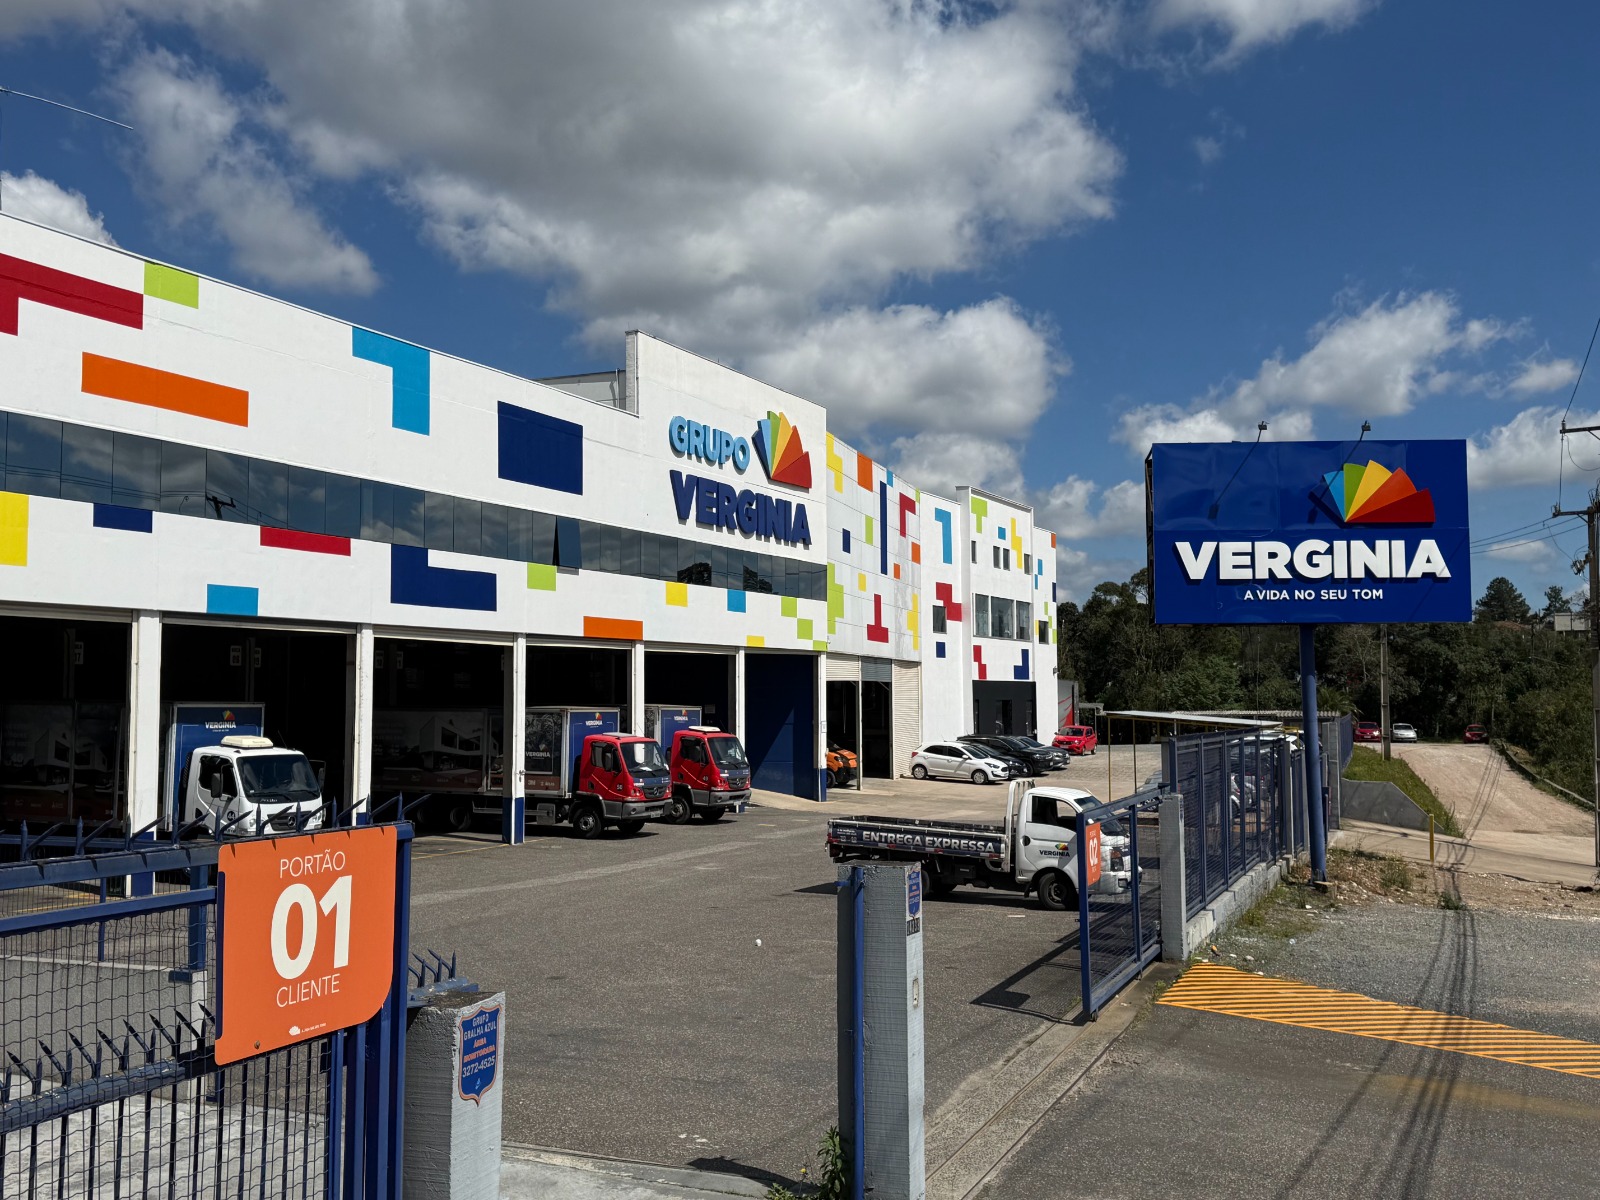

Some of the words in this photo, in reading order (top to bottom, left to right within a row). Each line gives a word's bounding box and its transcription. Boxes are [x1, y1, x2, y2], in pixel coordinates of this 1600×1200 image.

[669, 415, 751, 471] GRUPO
[669, 470, 812, 546] VERGINIA
[1174, 539, 1452, 580] VERGINIA
[1244, 590, 1254, 601] A
[1256, 589, 1290, 600] VIDA
[1294, 589, 1315, 600] NO
[1320, 589, 1347, 600] SEU
[1352, 588, 1384, 600] TOM
[204, 721, 237, 729] VERGINIA
[862, 830, 923, 847] ENTREGA
[925, 836, 995, 853] EXPRESSA
[1039, 849, 1071, 858] VERGINIA
[1089, 837, 1099, 867] 02
[279, 848, 346, 879] PORTÃO
[270, 875, 352, 980] 01
[276, 973, 340, 1008] CLIENTE
[463, 1027, 484, 1041] GRALHA
[484, 1021, 497, 1034] AZUL
[472, 1013, 490, 1027] GRUPO
[462, 1054, 496, 1078] 3272-4525
